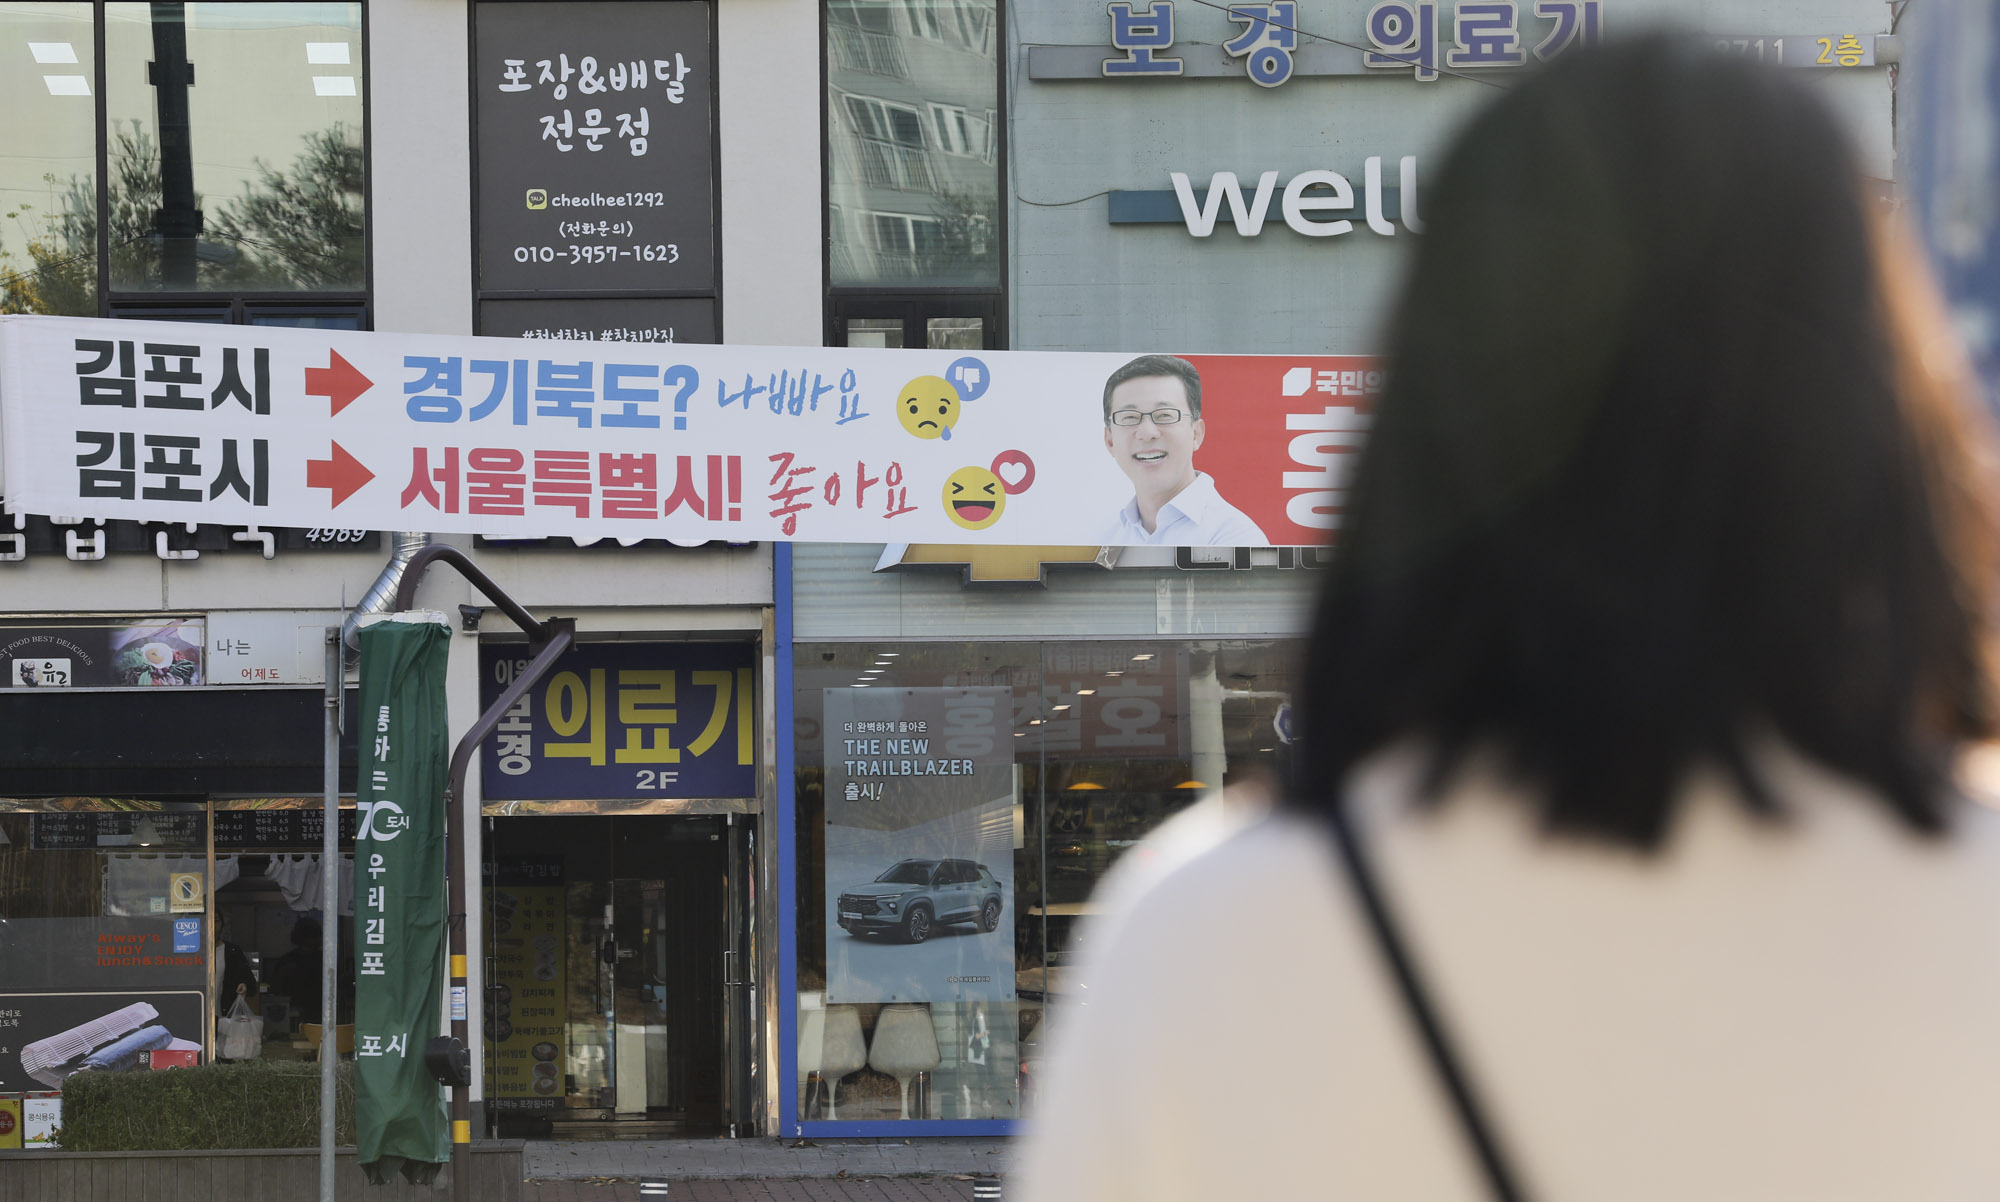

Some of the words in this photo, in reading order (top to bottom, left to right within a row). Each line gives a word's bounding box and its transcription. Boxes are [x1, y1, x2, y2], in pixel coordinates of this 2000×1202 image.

[1364, 0, 1603, 82] 의료기
[1816, 34, 1865, 67] 2층
[499, 53, 691, 104] 포장&배달
[539, 107, 649, 157] 전문점
[551, 192, 664, 207] cheolhee1292
[1170, 155, 1426, 237] well
[514, 244, 679, 264] 010-3957-1623
[75, 339, 271, 415] 김포시
[403, 355, 699, 430] 경기북도?
[718, 368, 870, 426] 나빠요
[75, 430, 271, 506] 김포시
[401, 446, 742, 521] 서울특별시!
[768, 452, 918, 536] 좋아요
[8, 637, 31, 650] FOOD
[32, 635, 55, 643] BEST
[56, 638, 93, 667] DELICIOUS
[217, 639, 250, 656] 나는
[241, 667, 280, 680] 어제도
[544, 667, 753, 766] 의료기
[844, 722, 853, 733] 더
[857, 721, 895, 733] 완벽하게
[899, 721, 928, 733] 돌아온
[844, 739, 880, 755] THE
[886, 739, 929, 755] NEW
[844, 759, 974, 776] TRAILBLAZER
[636, 769, 679, 789] 2F
[844, 781, 884, 801] 출시!
[175, 921, 198, 930] CESCO
[97, 945, 143, 956] ENJOY
[28, 1112, 55, 1122] 콩식용유
